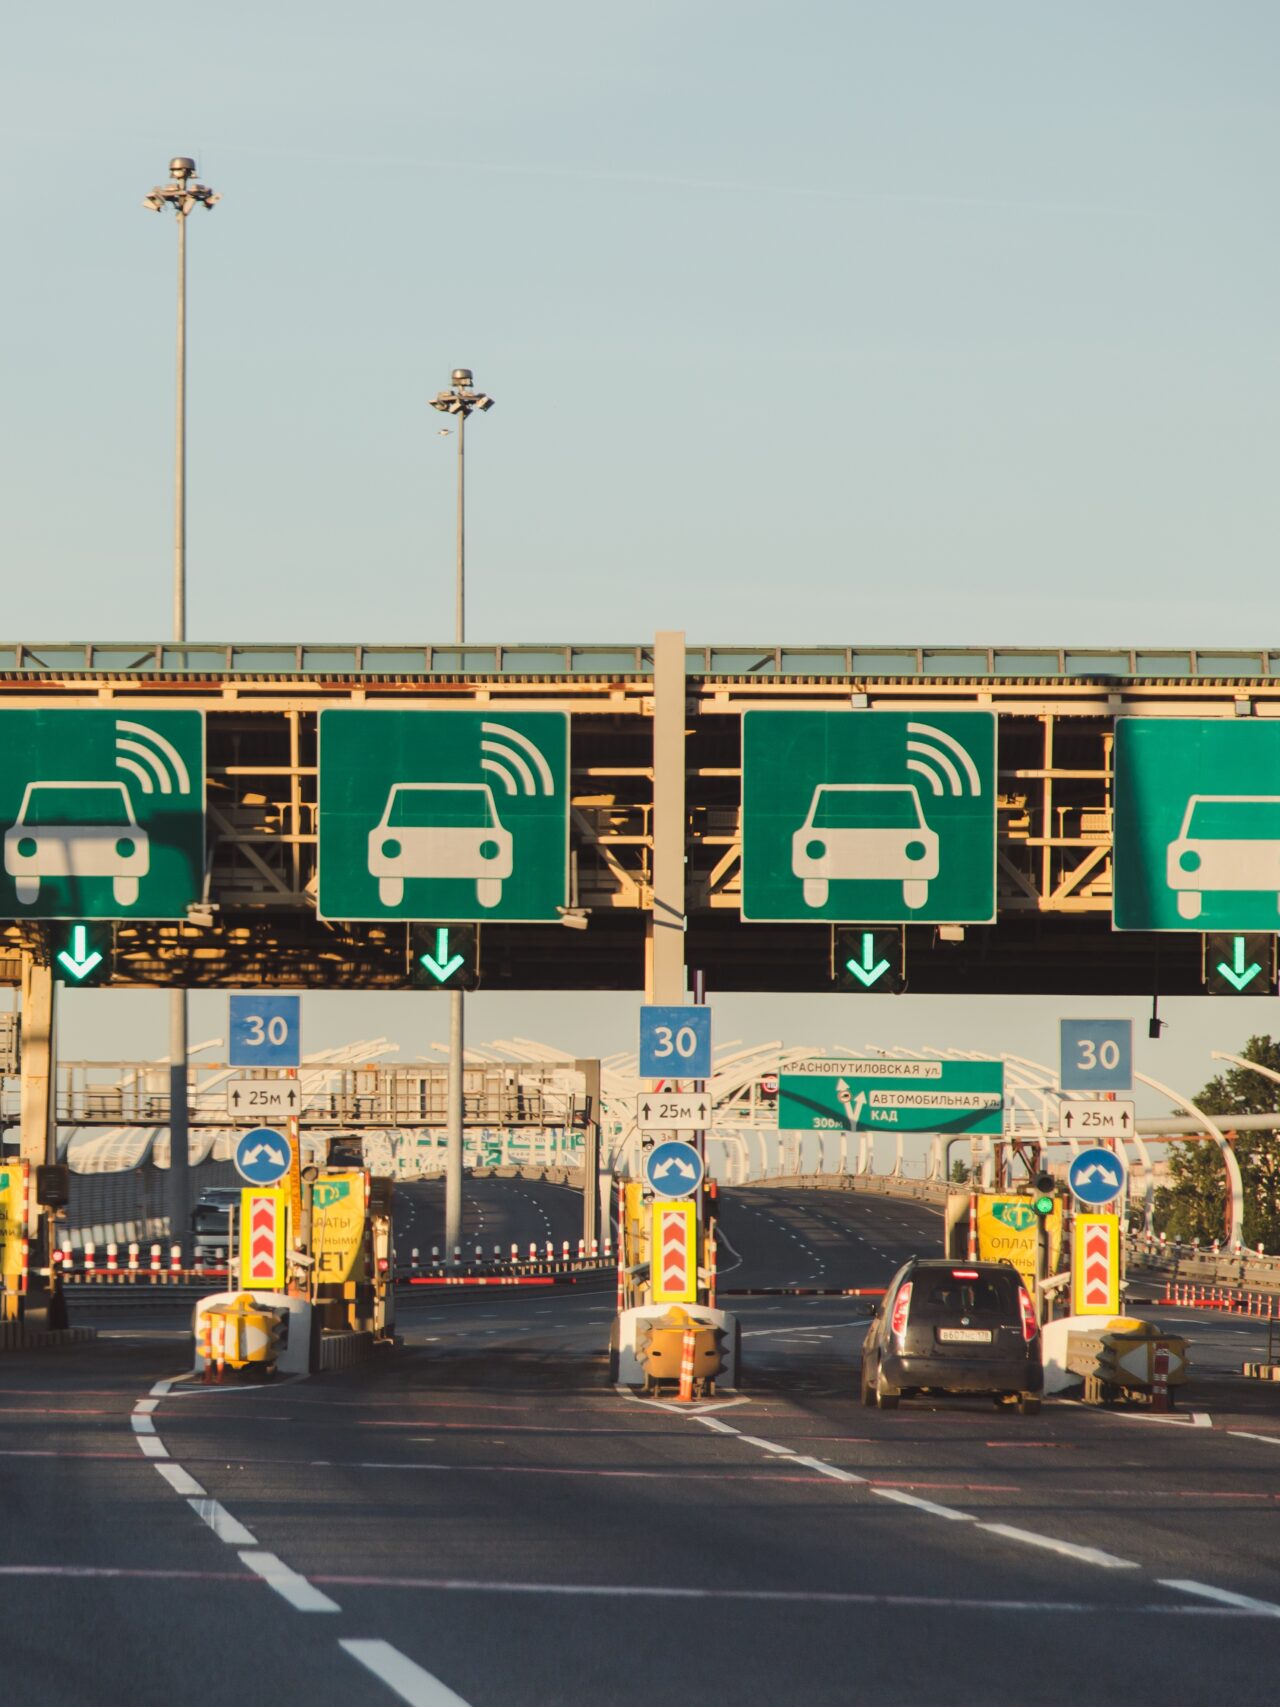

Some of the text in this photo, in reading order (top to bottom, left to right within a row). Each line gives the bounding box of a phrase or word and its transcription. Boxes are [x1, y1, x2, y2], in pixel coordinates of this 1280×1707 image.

[245, 1015, 288, 1046] 30
[654, 1026, 697, 1057] 30
[1076, 1040, 1120, 1070] 30
[783, 1061, 941, 1077] КРАСНОПУТИЛОВСКАЯ ул.
[249, 1091, 282, 1105] 25м
[873, 1094, 980, 1106] АВТОМОБИЛЬНАЯ
[659, 1104, 692, 1118] 25м
[871, 1110, 898, 1122] КАД
[1082, 1112, 1114, 1126] 25м
[314, 1217, 351, 1229] ЛАТЫ
[991, 1238, 1034, 1249] ОПЛАТ
[321, 1252, 349, 1272] ЕТ
